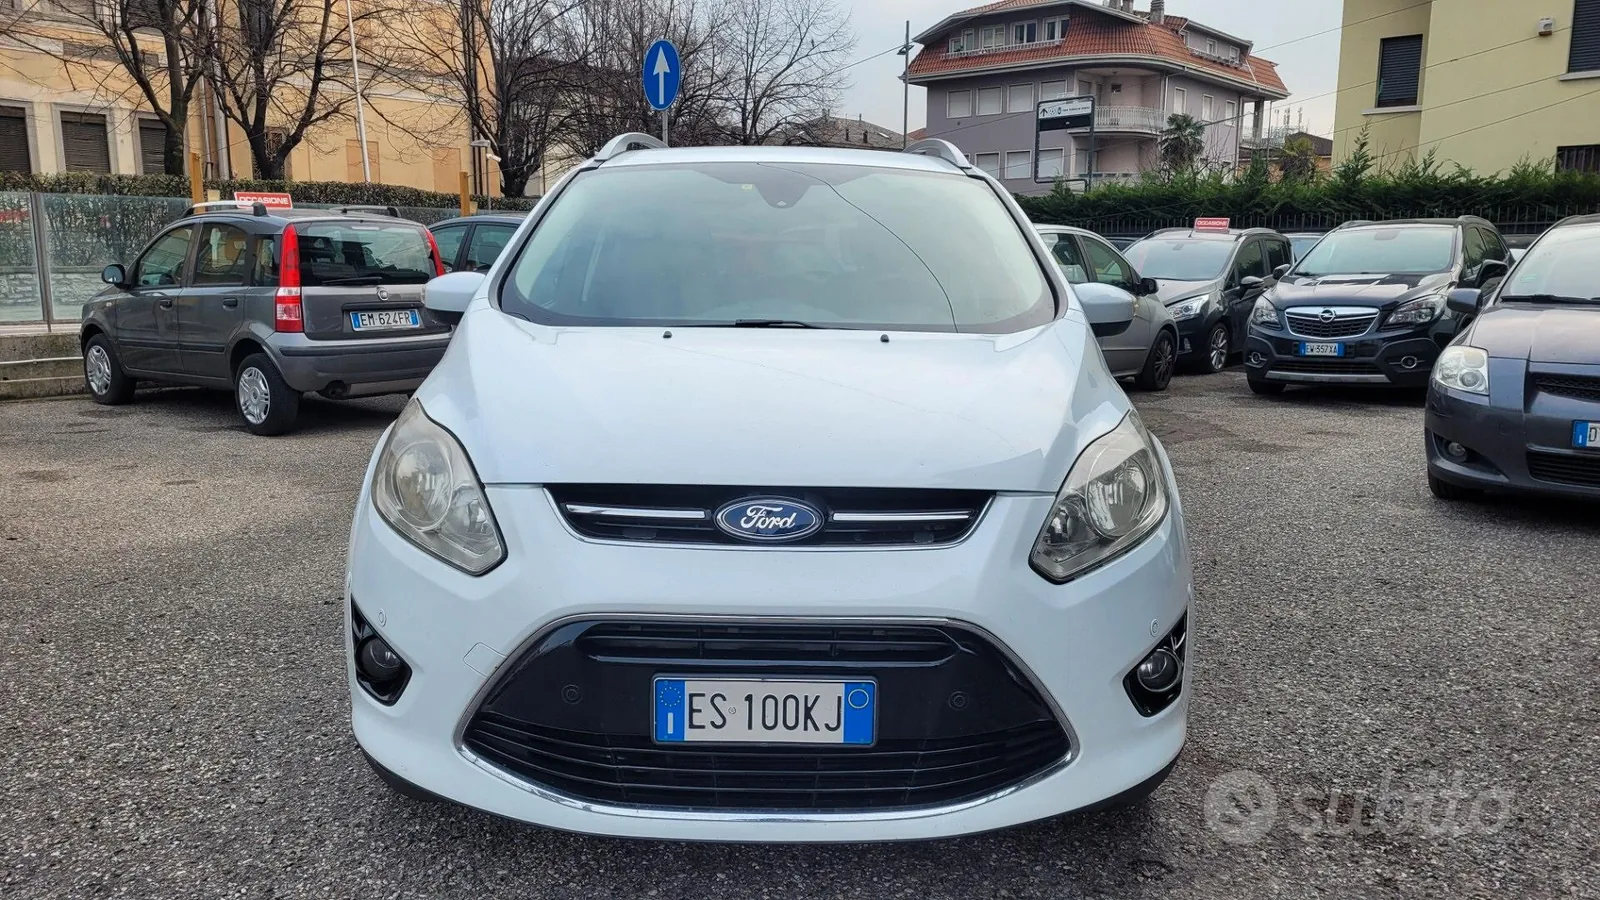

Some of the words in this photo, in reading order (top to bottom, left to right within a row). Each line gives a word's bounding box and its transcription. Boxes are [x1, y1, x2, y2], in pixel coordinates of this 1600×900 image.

[239, 196, 289, 205] OCCASIONE
[360, 313, 375, 326] EM
[379, 311, 411, 325] 624FR
[1588, 427, 1600, 442] D
[740, 505, 797, 529] Ford
[688, 693, 727, 729] ES
[744, 694, 842, 731] 100KJ
